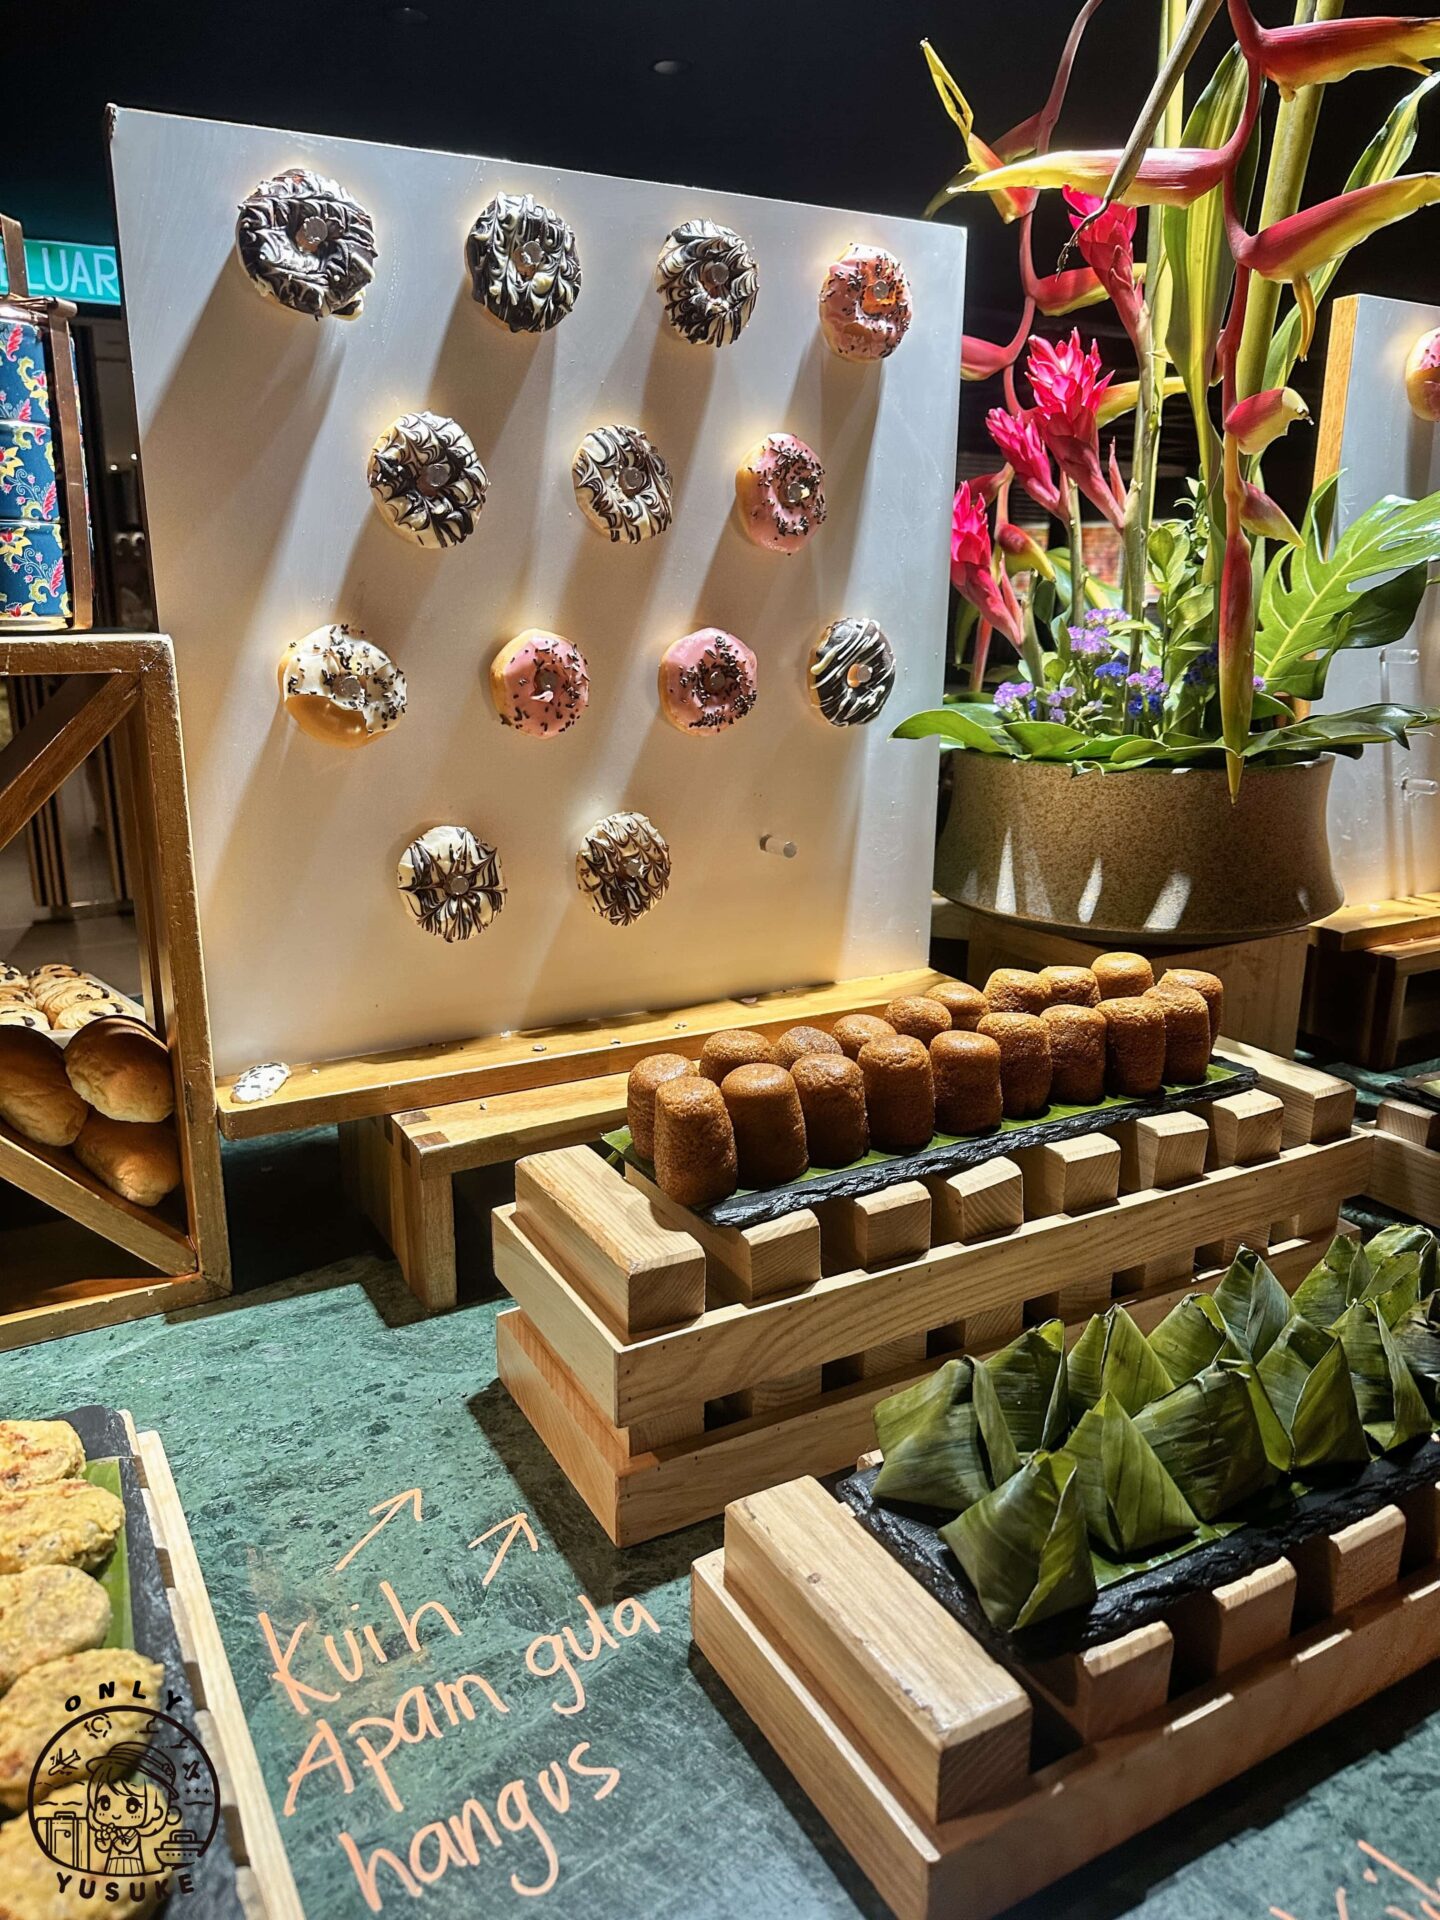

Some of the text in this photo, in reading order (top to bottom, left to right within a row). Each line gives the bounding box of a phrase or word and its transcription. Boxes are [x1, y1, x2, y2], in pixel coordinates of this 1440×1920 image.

[258, 1580, 463, 1715] Kuih
[283, 1594, 661, 1818] Apam gula
[338, 1742, 621, 1912] hangus
